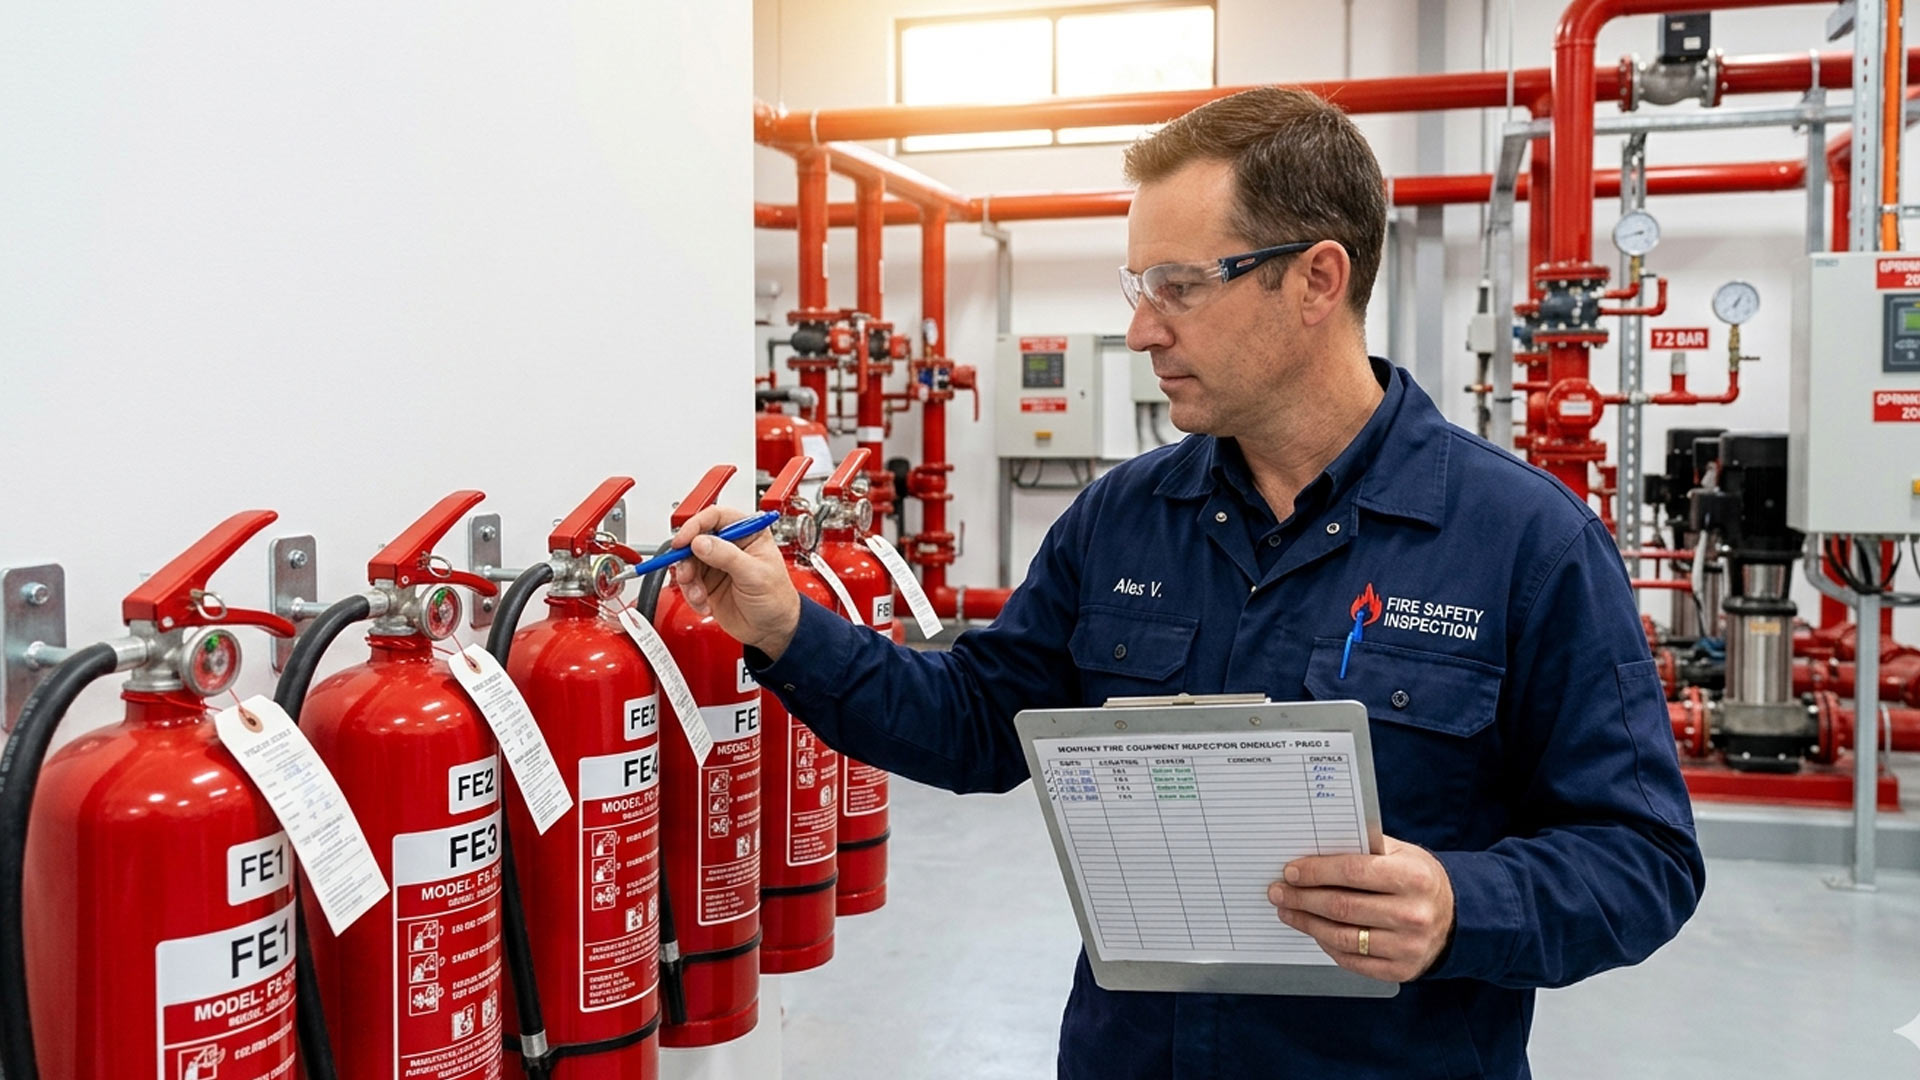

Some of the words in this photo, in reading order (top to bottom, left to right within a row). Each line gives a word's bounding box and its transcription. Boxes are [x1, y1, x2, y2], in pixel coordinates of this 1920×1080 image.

[1676, 331, 1705, 346] BAR
[1113, 577, 1146, 596] Ales
[1151, 581, 1162, 598] V.
[1383, 612, 1478, 641] INSPECTION
[1386, 597, 1421, 614] FIRE
[1423, 602, 1484, 624] SAFETY
[458, 767, 494, 801] FE2
[450, 823, 498, 869] FE3
[241, 844, 283, 887] FE1
[231, 917, 289, 979] FE1
[194, 989, 264, 1022] MODEL:
